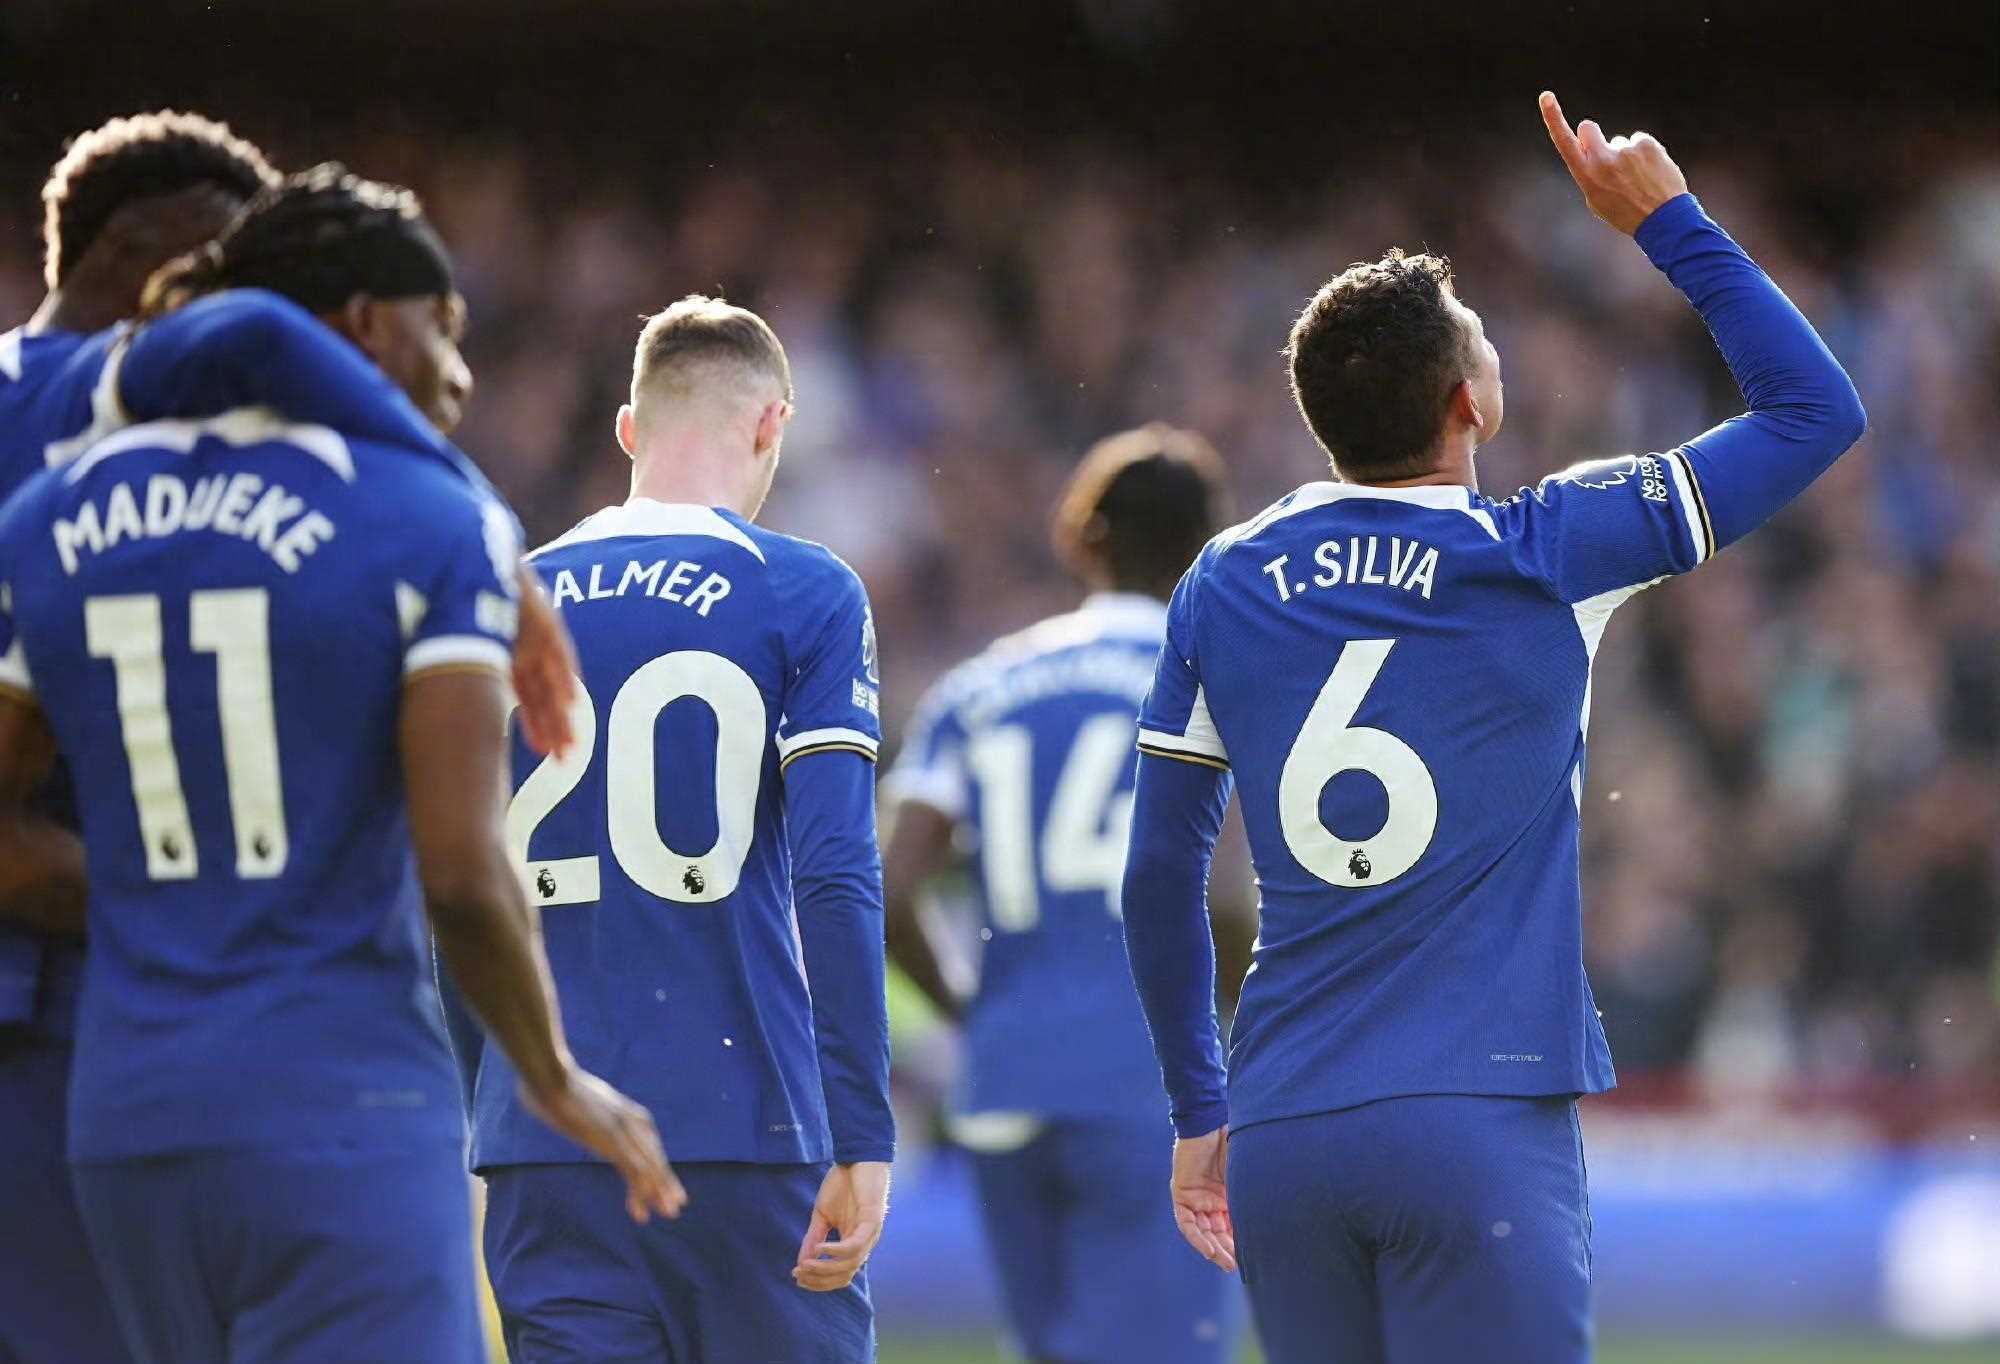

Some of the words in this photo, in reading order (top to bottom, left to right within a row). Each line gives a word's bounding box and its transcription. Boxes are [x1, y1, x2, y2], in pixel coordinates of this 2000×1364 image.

[53, 472, 336, 574] MADUEKE
[536, 559, 731, 617] ALMER
[84, 587, 288, 880] 11
[506, 649, 767, 905] 20
[969, 712, 1135, 931] 14
[1279, 639, 1438, 887] 6
